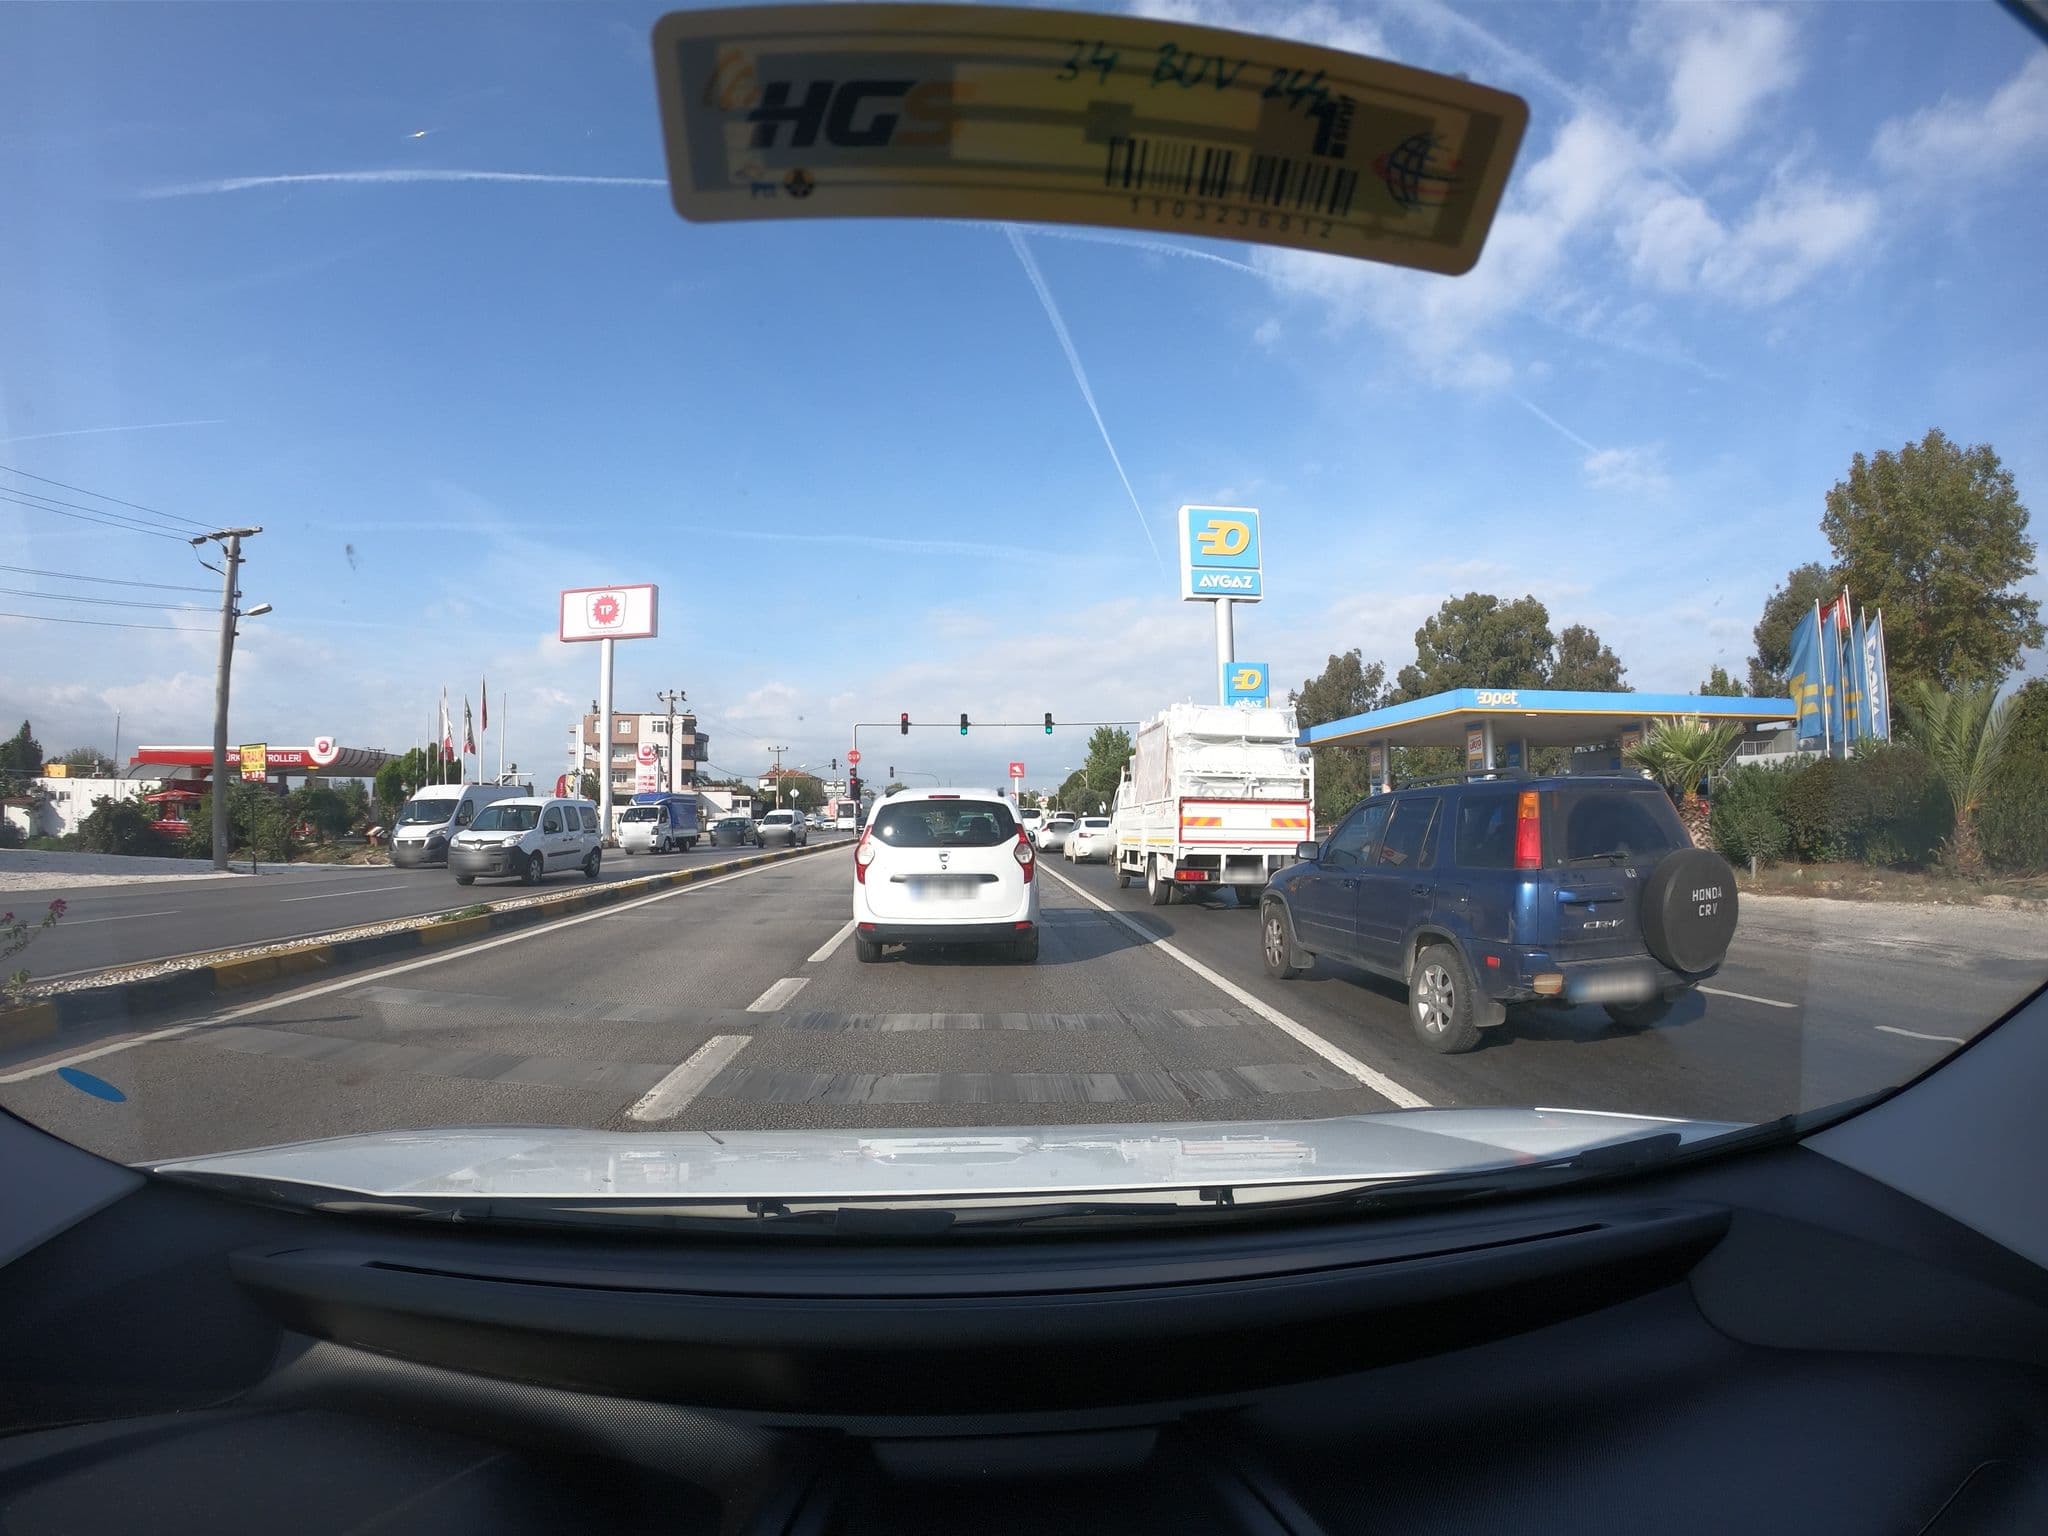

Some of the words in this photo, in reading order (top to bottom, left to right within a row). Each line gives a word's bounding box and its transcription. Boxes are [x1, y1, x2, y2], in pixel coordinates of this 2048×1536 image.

[1056, 40, 1120, 86] 34
[1152, 42, 1248, 91] BUV
[748, 79, 979, 147] HGS
[1199, 574, 1253, 589] AYGAZ
[599, 605, 613, 616] TP
[1477, 690, 1519, 706] opet
[1692, 886, 1722, 902] HONDA
[1698, 903, 1717, 917] CRV
